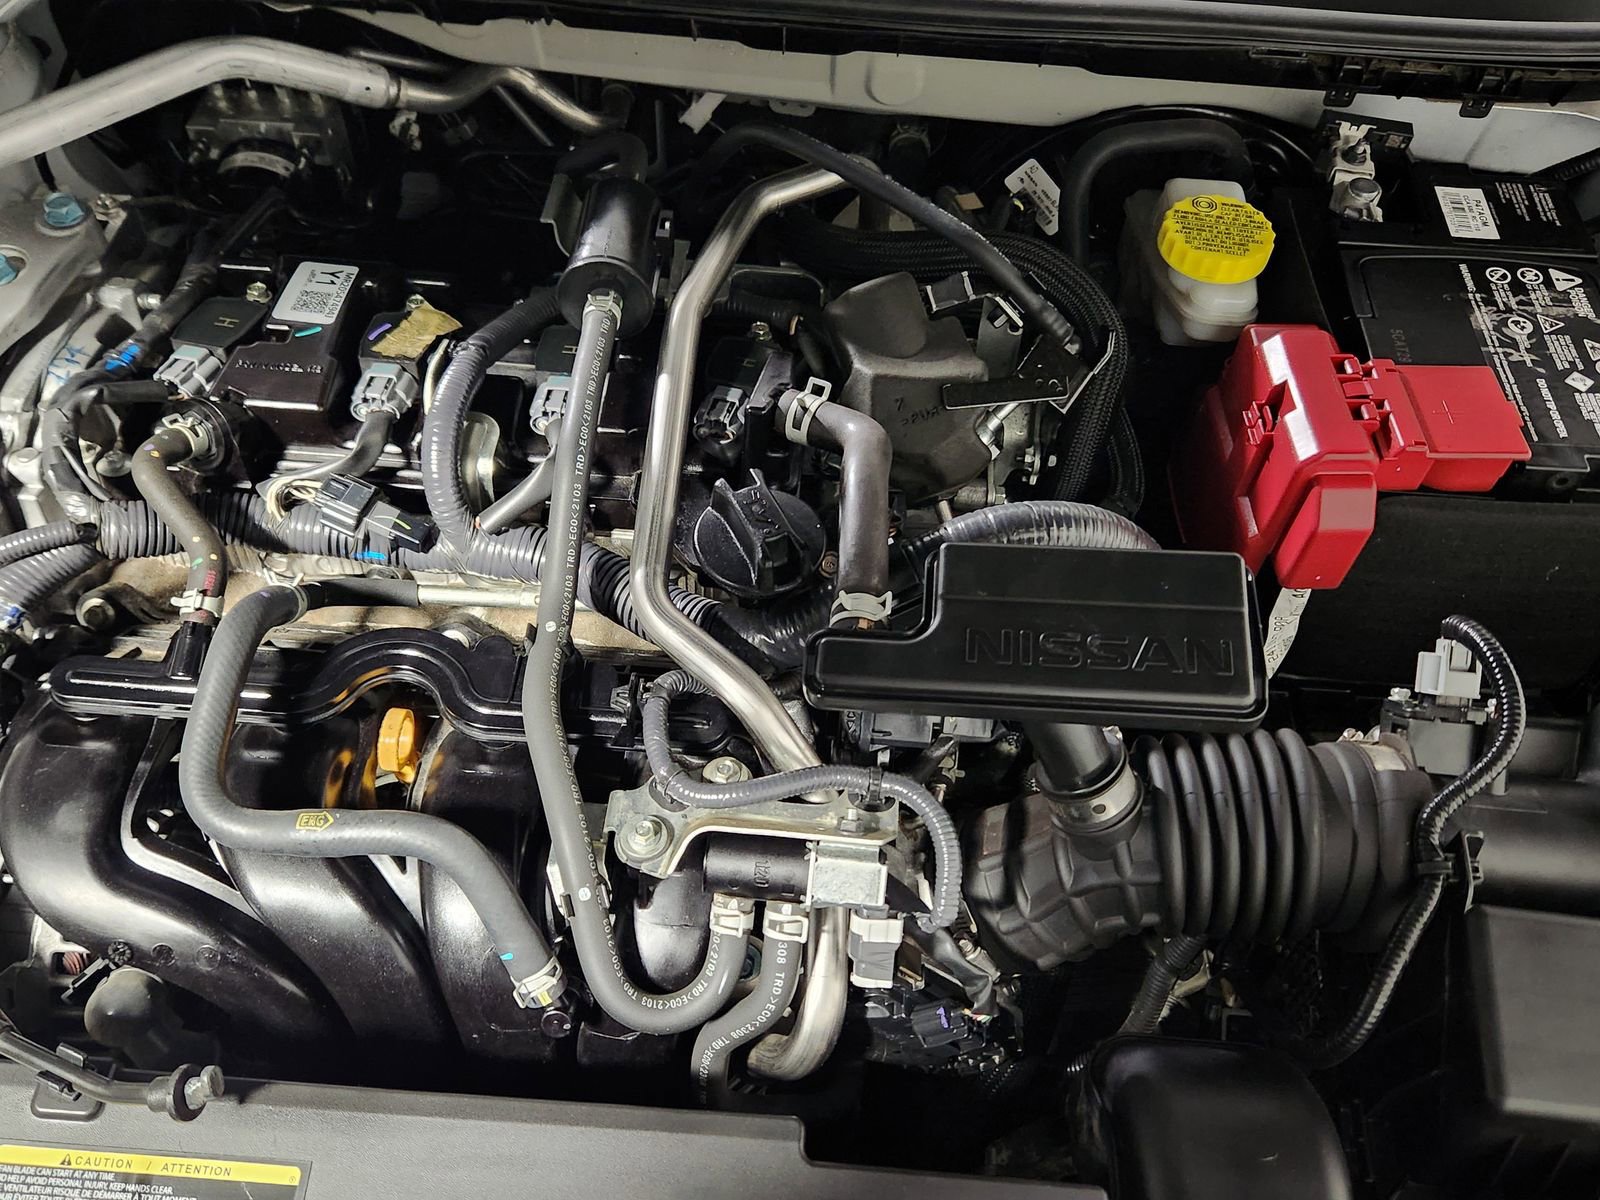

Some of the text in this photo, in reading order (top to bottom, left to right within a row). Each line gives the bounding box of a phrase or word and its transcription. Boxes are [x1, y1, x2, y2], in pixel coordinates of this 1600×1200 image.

[315, 270, 344, 286] Y1
[567, 483, 582, 568] TRD>ECO<2103
[965, 627, 1234, 676] NISSAN
[301, 815, 324, 827] ENG
[730, 971, 786, 1040] TRD>ECO<2308
[13, 1166, 36, 1174] BLADE
[36, 1168, 52, 1177] CAN
[52, 1169, 73, 1178] START
[73, 1171, 83, 1179] AT
[83, 1171, 98, 1180] ANY
[75, 1155, 133, 1169] CAUTION
[160, 1163, 232, 1177] ATTENTION
[4, 1183, 53, 1194] VENTILATEUR
[53, 1187, 81, 1197] RISQUE
[81, 1190, 92, 1198] DE
[7, 1174, 26, 1183] HELP
[26, 1176, 48, 1185] AVOID
[48, 1177, 82, 1188] PERSONAL
[109, 1182, 126, 1191] KEEP
[126, 1184, 150, 1193] HANDS
